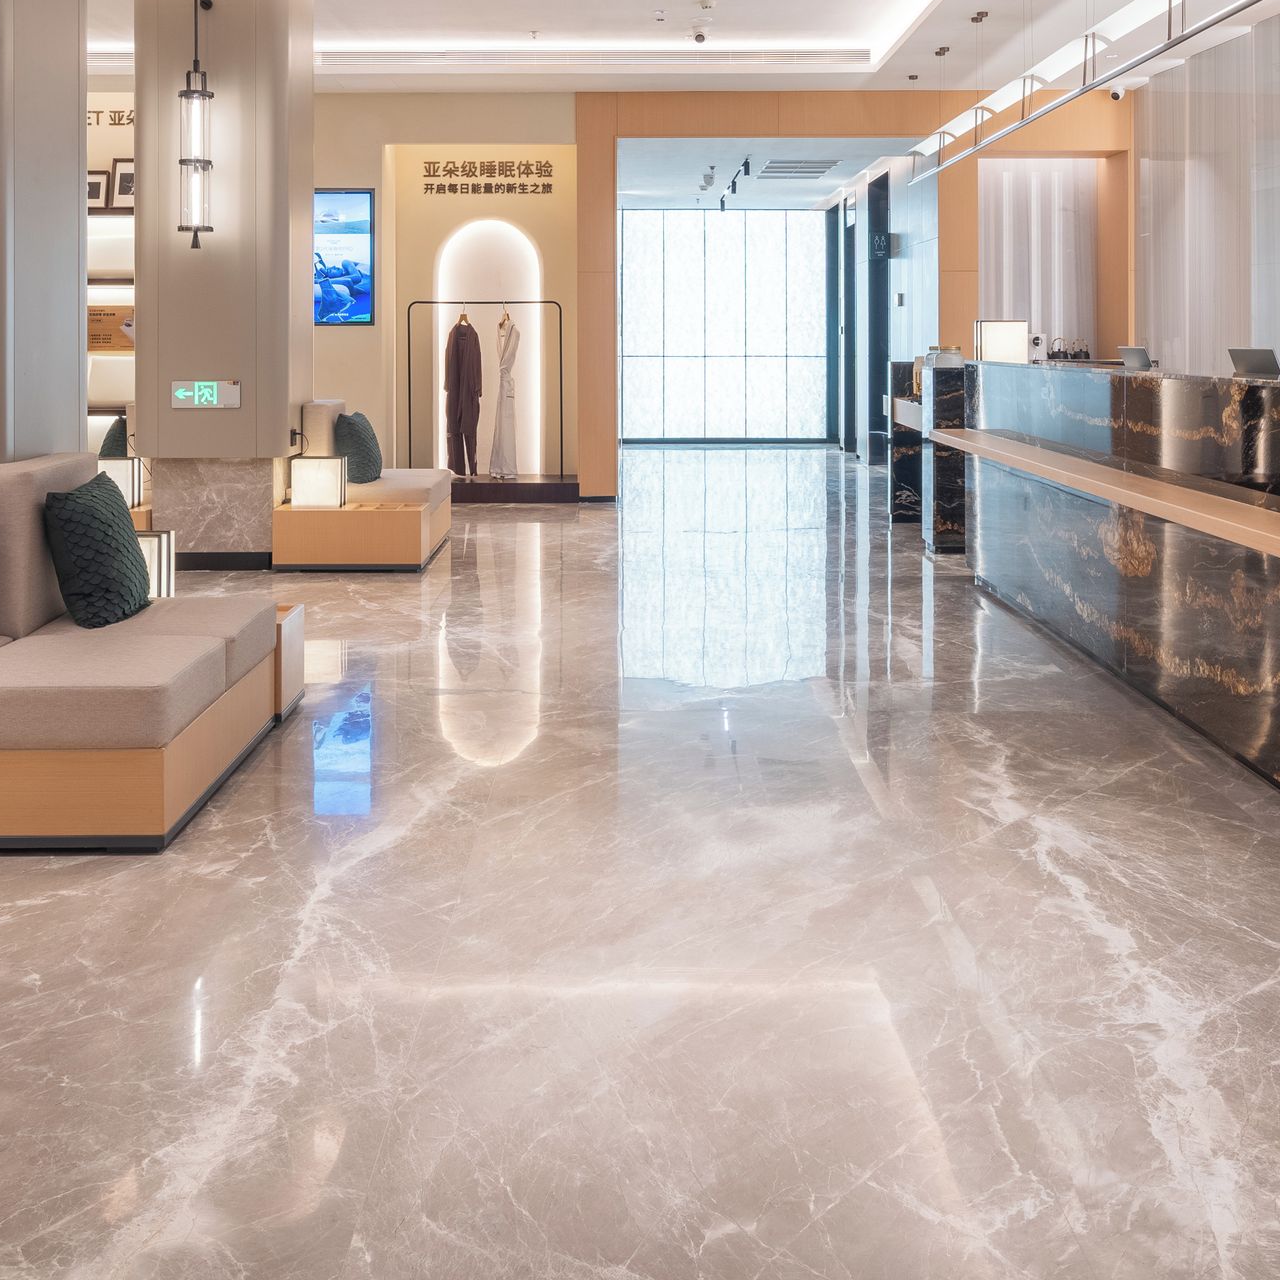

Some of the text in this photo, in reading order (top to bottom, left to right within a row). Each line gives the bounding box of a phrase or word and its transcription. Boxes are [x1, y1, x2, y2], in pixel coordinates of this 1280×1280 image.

[423, 160, 553, 179] 亚朵级睡眠体验
[423, 182, 553, 195] 开启每日能量的新生之旅
